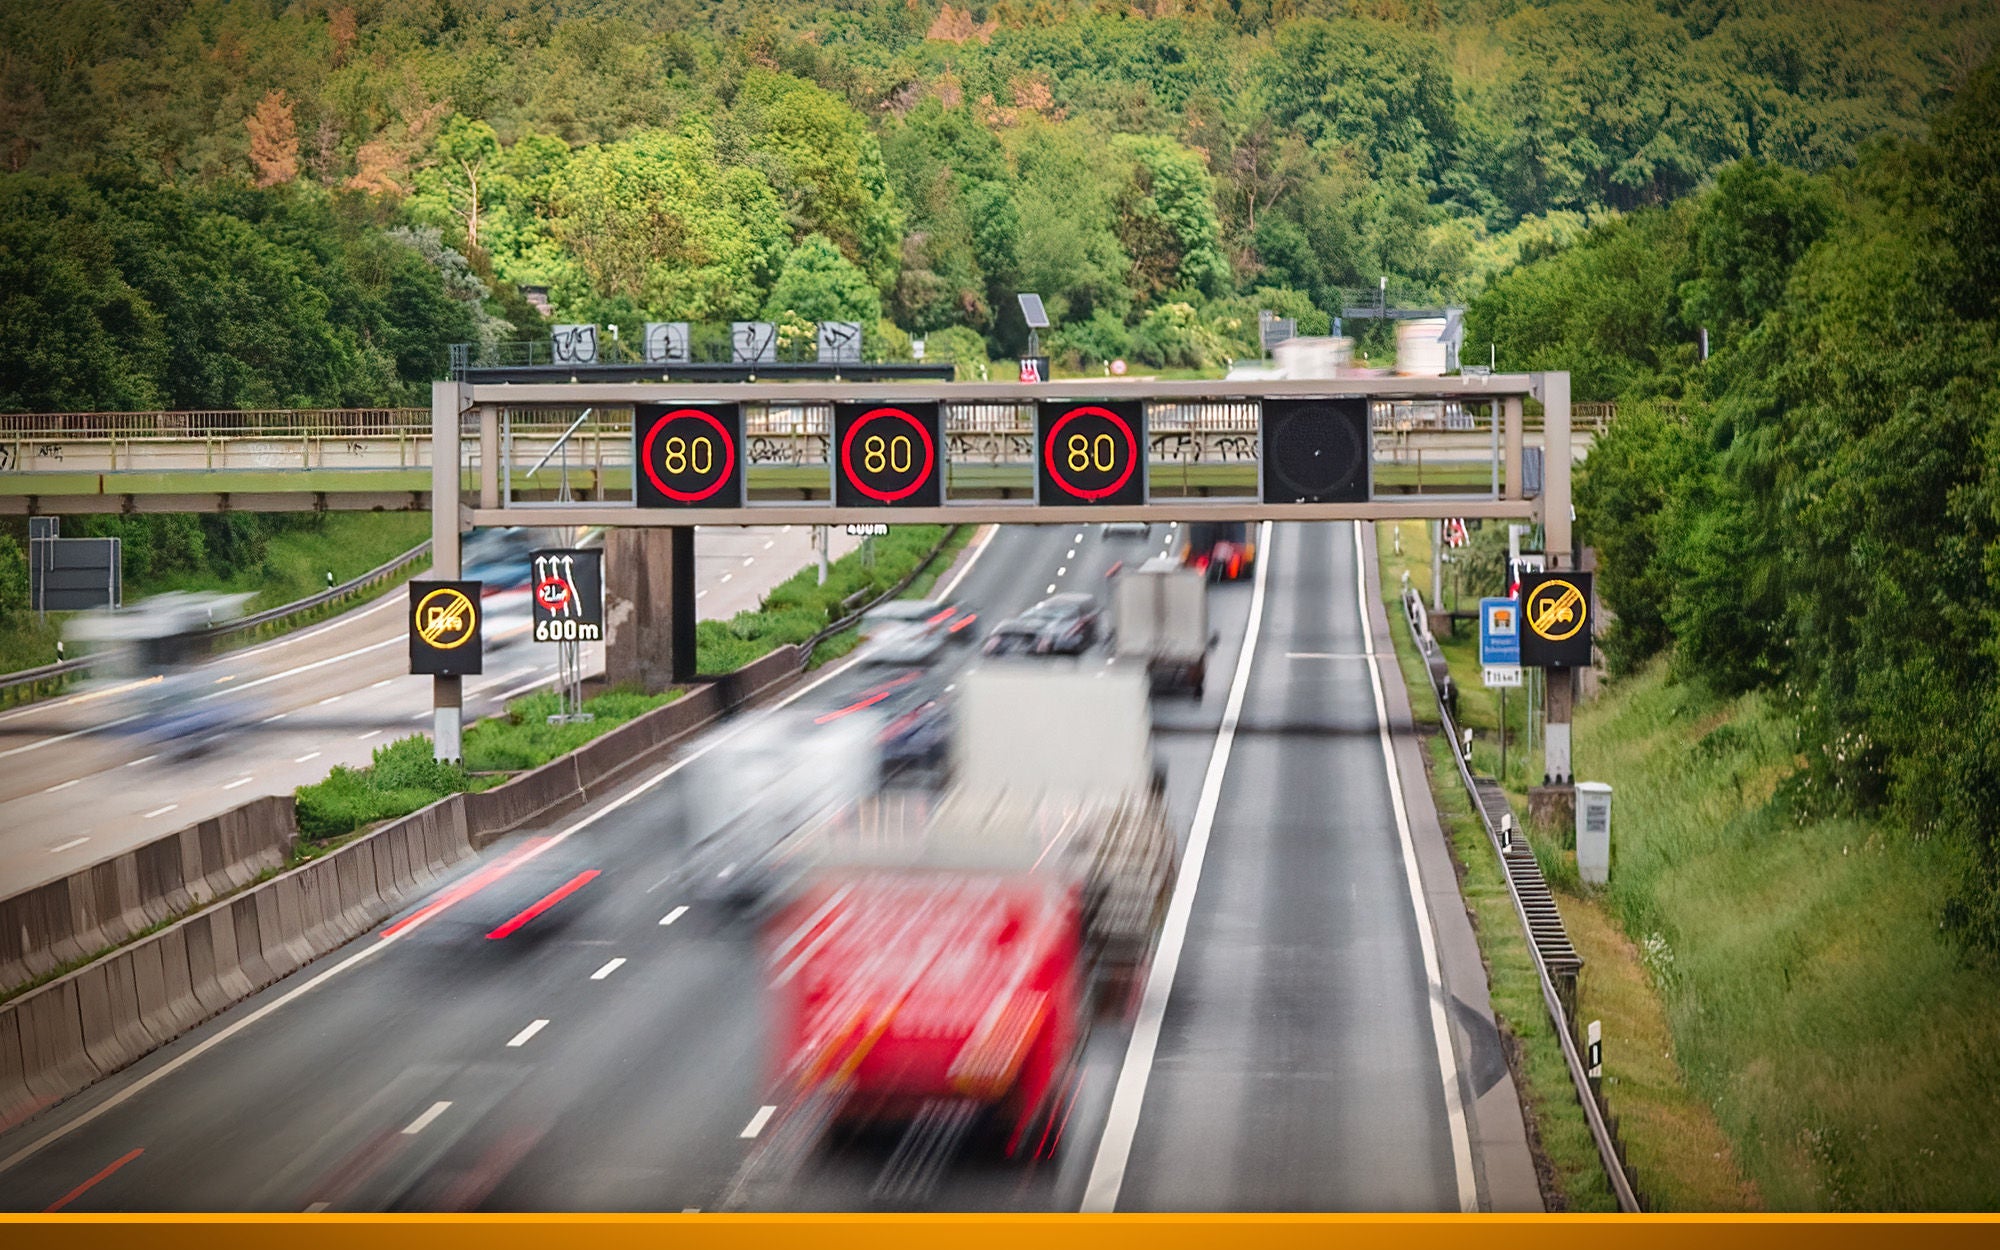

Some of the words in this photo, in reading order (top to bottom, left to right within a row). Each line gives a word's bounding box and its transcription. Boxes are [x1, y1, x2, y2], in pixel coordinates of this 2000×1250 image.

[665, 436, 712, 474] 80
[865, 435, 911, 473] 80
[1068, 433, 1115, 472] 80
